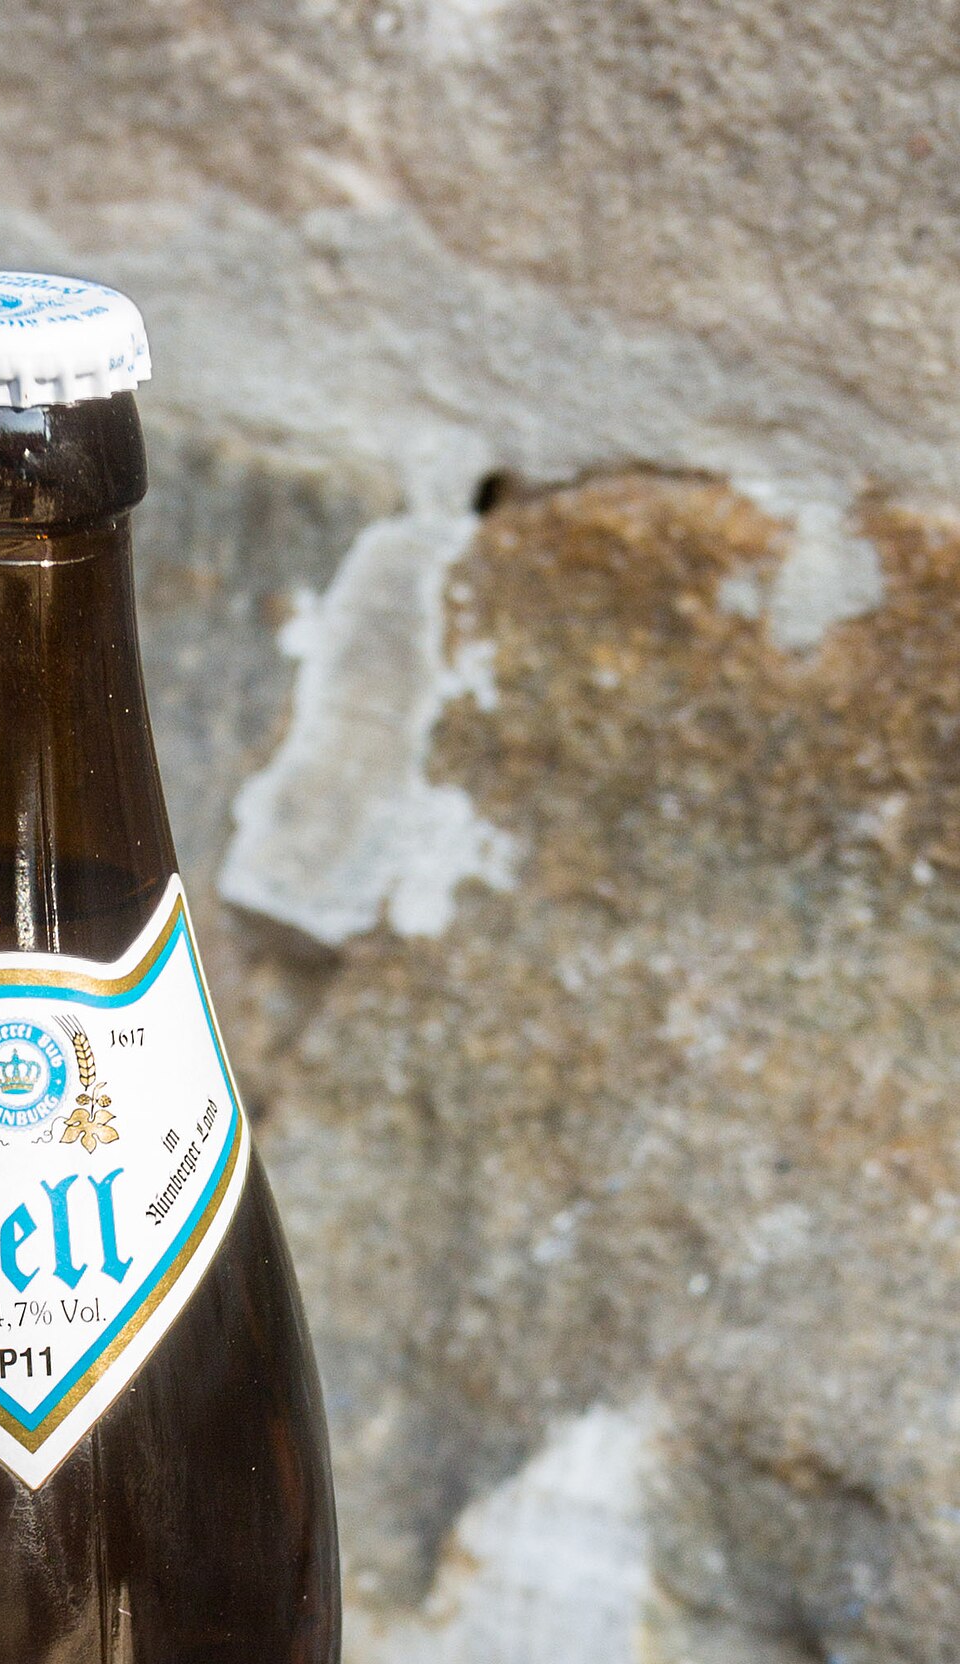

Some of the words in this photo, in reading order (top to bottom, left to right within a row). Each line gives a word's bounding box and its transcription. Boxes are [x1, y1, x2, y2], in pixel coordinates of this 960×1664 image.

[37, 1028, 64, 1069] Bub
[109, 1027, 146, 1048] 1617
[161, 1128, 180, 1154] im
[145, 1141, 201, 1226] Nürnberger
[196, 1096, 218, 1143] Land
[61, 1297, 107, 1323] Vol.
